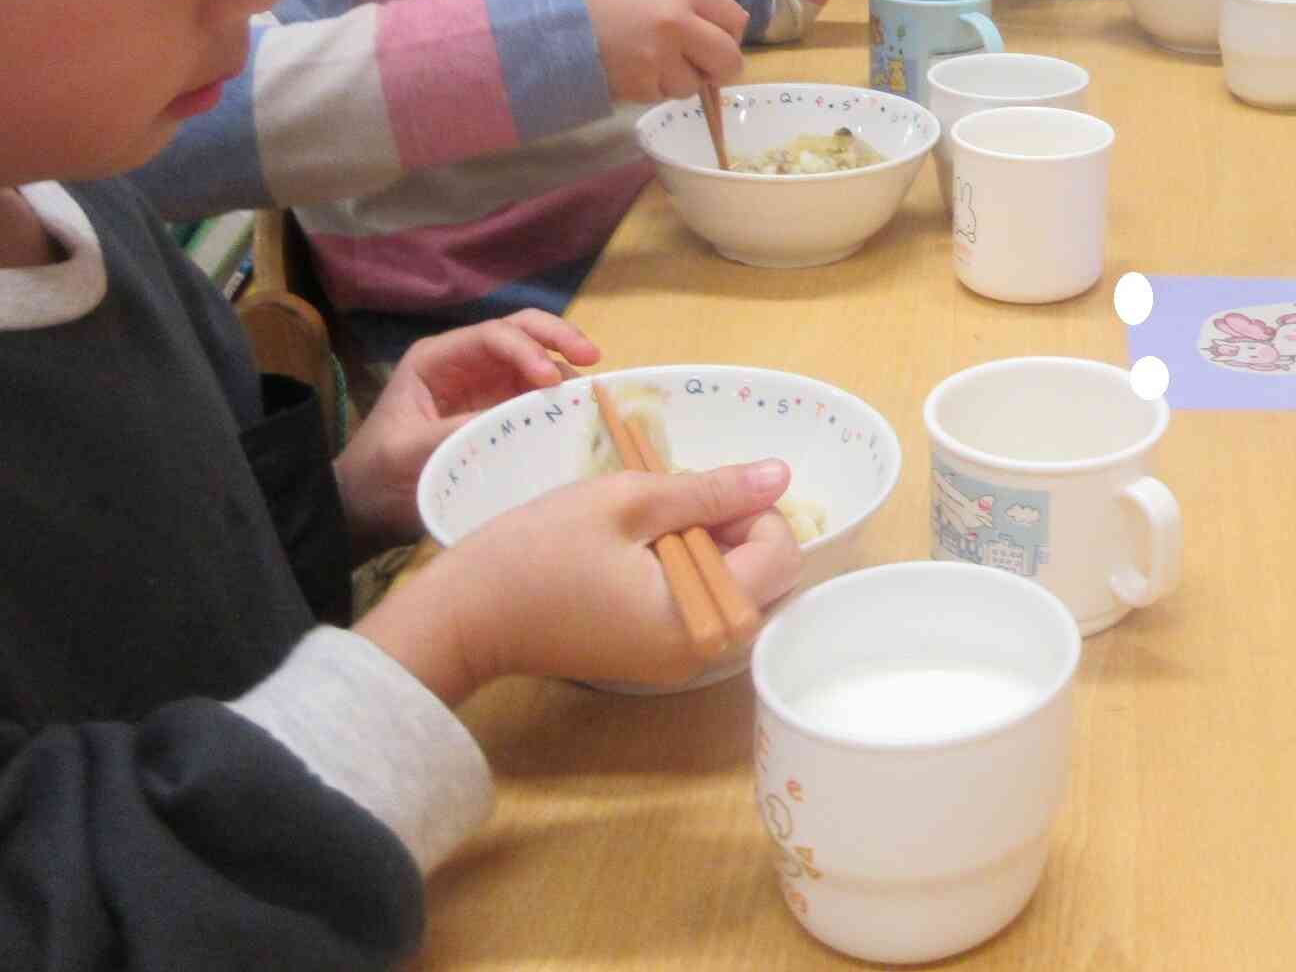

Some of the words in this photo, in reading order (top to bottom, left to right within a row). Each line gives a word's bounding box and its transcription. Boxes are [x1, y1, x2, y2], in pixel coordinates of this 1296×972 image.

[686, 379, 704, 395] Q
[777, 398, 790, 415] S
[544, 403, 563, 423] N
